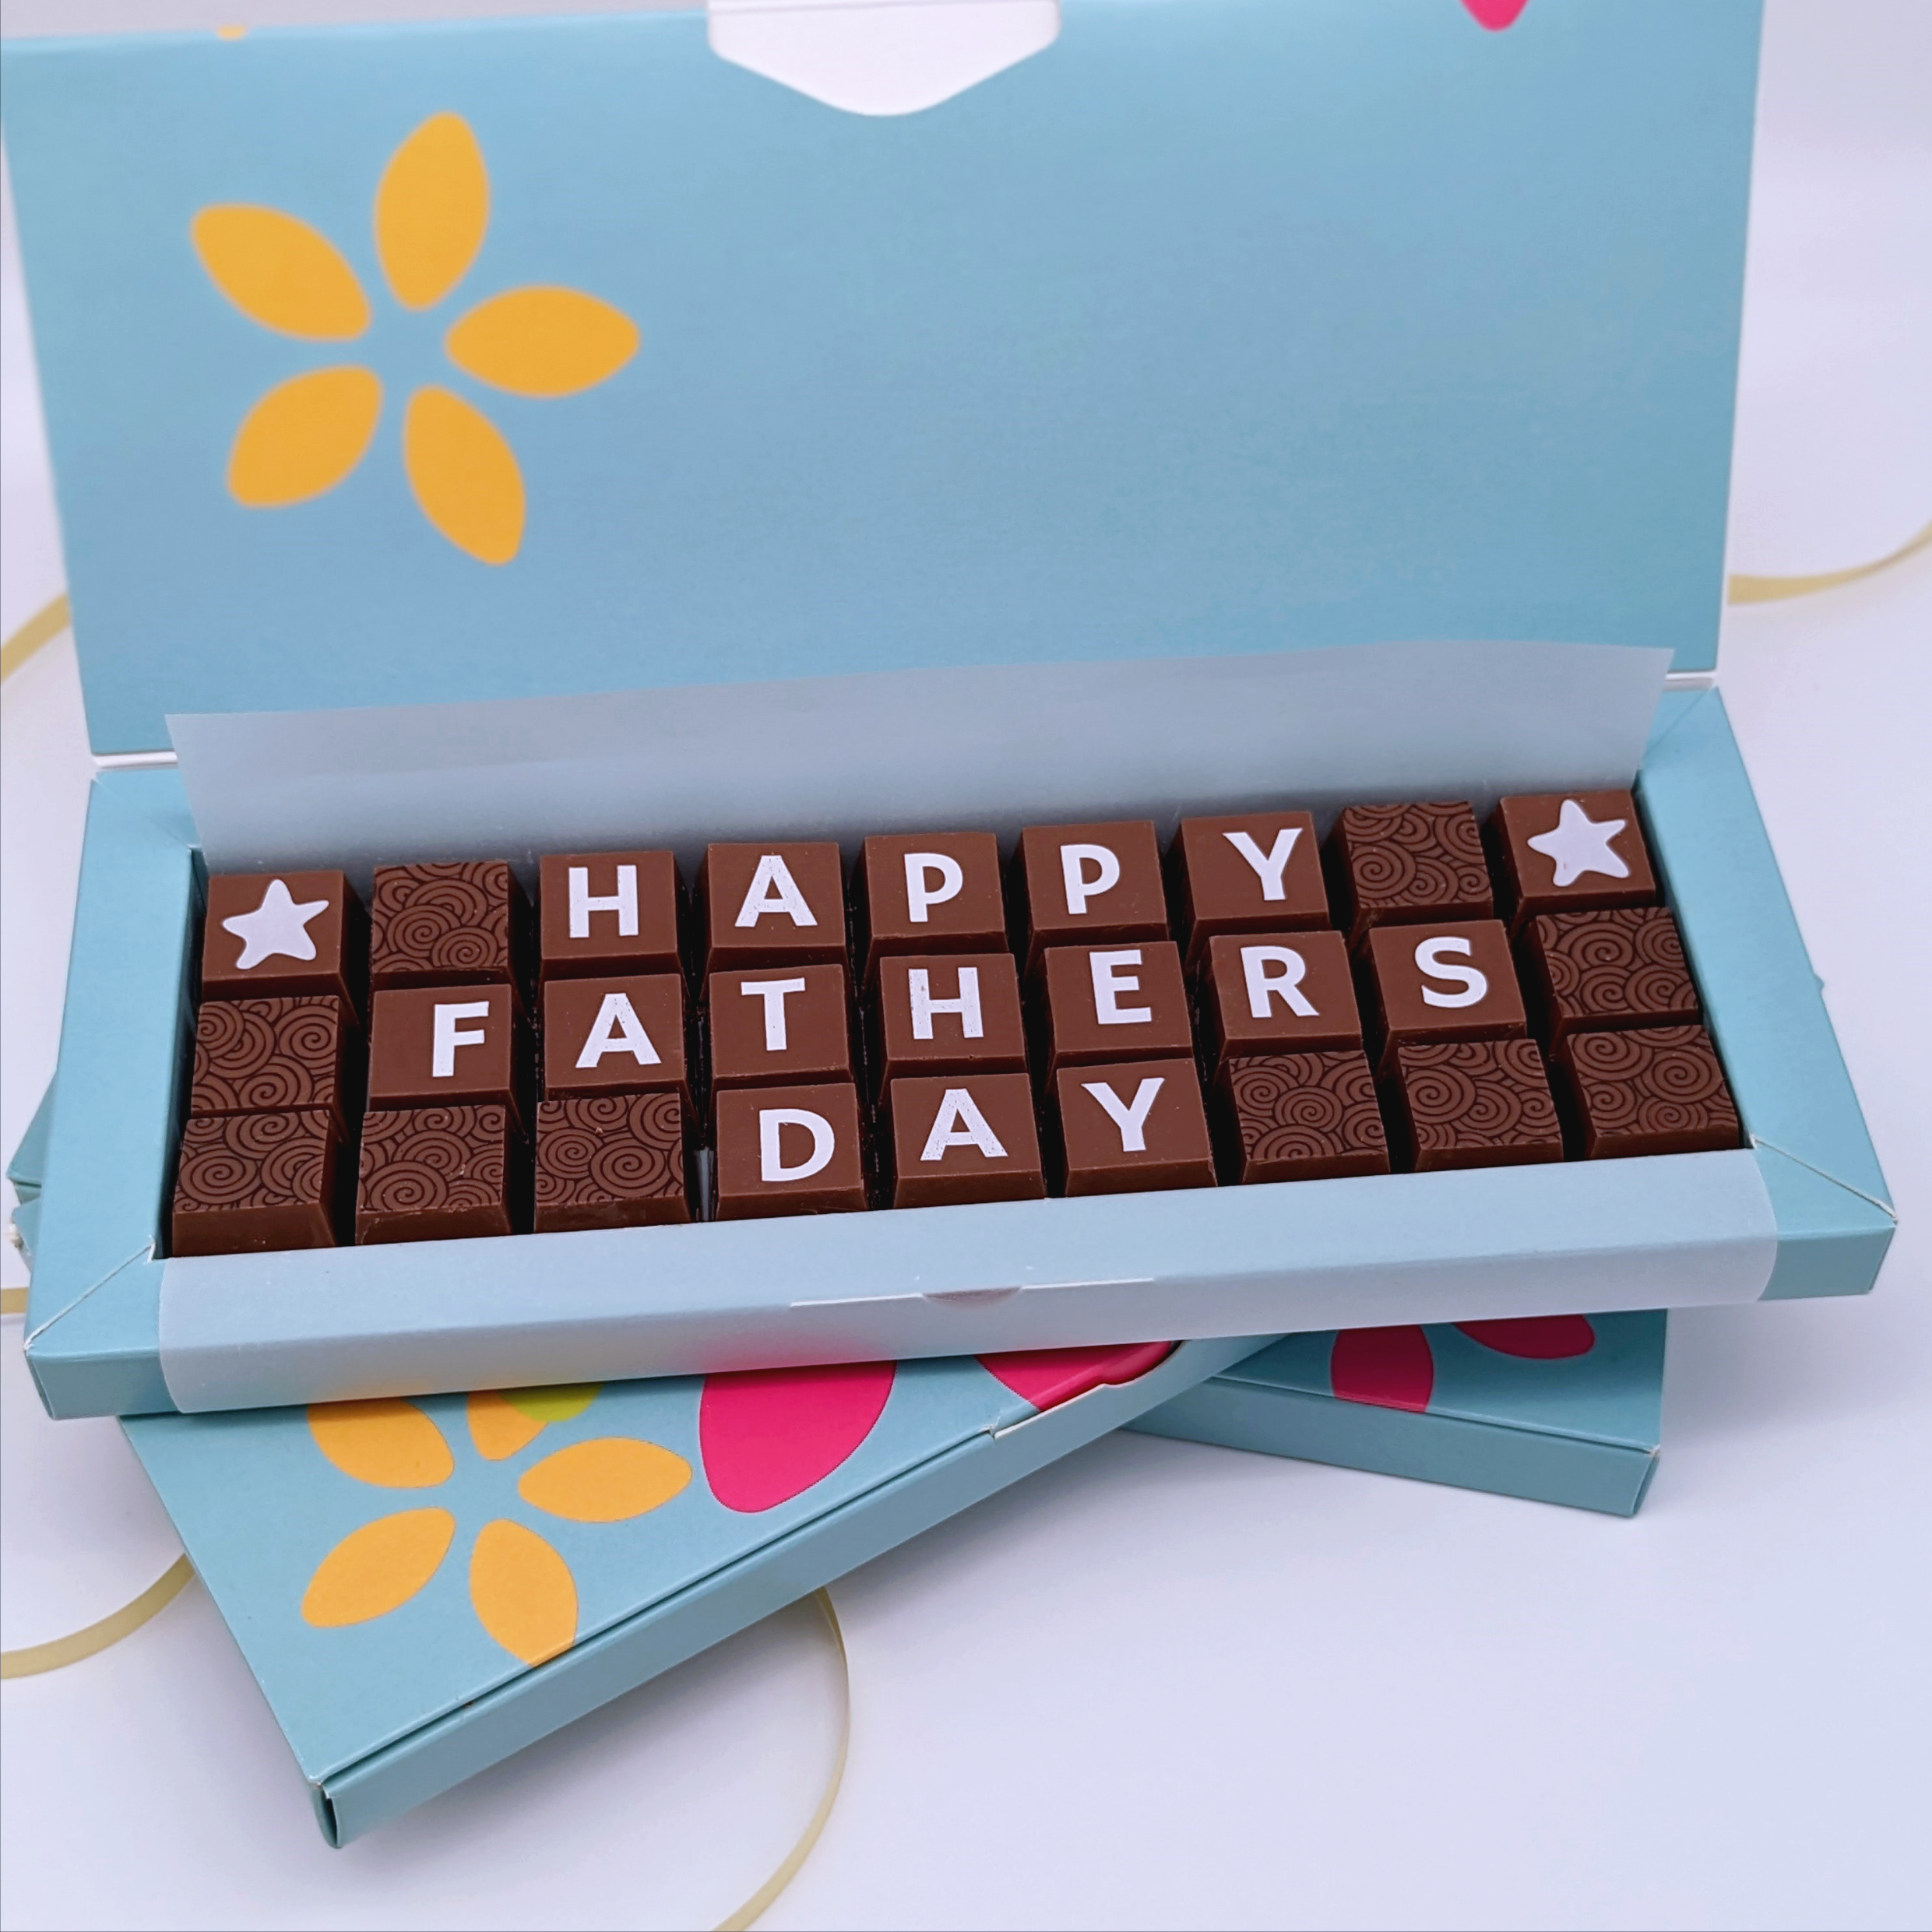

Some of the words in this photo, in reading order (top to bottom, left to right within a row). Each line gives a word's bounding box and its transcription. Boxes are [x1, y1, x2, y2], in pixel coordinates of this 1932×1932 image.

[568, 827, 1304, 939] HAPPY
[431, 935, 1488, 1079] FATHERS
[758, 1076, 1166, 1183] DAY
